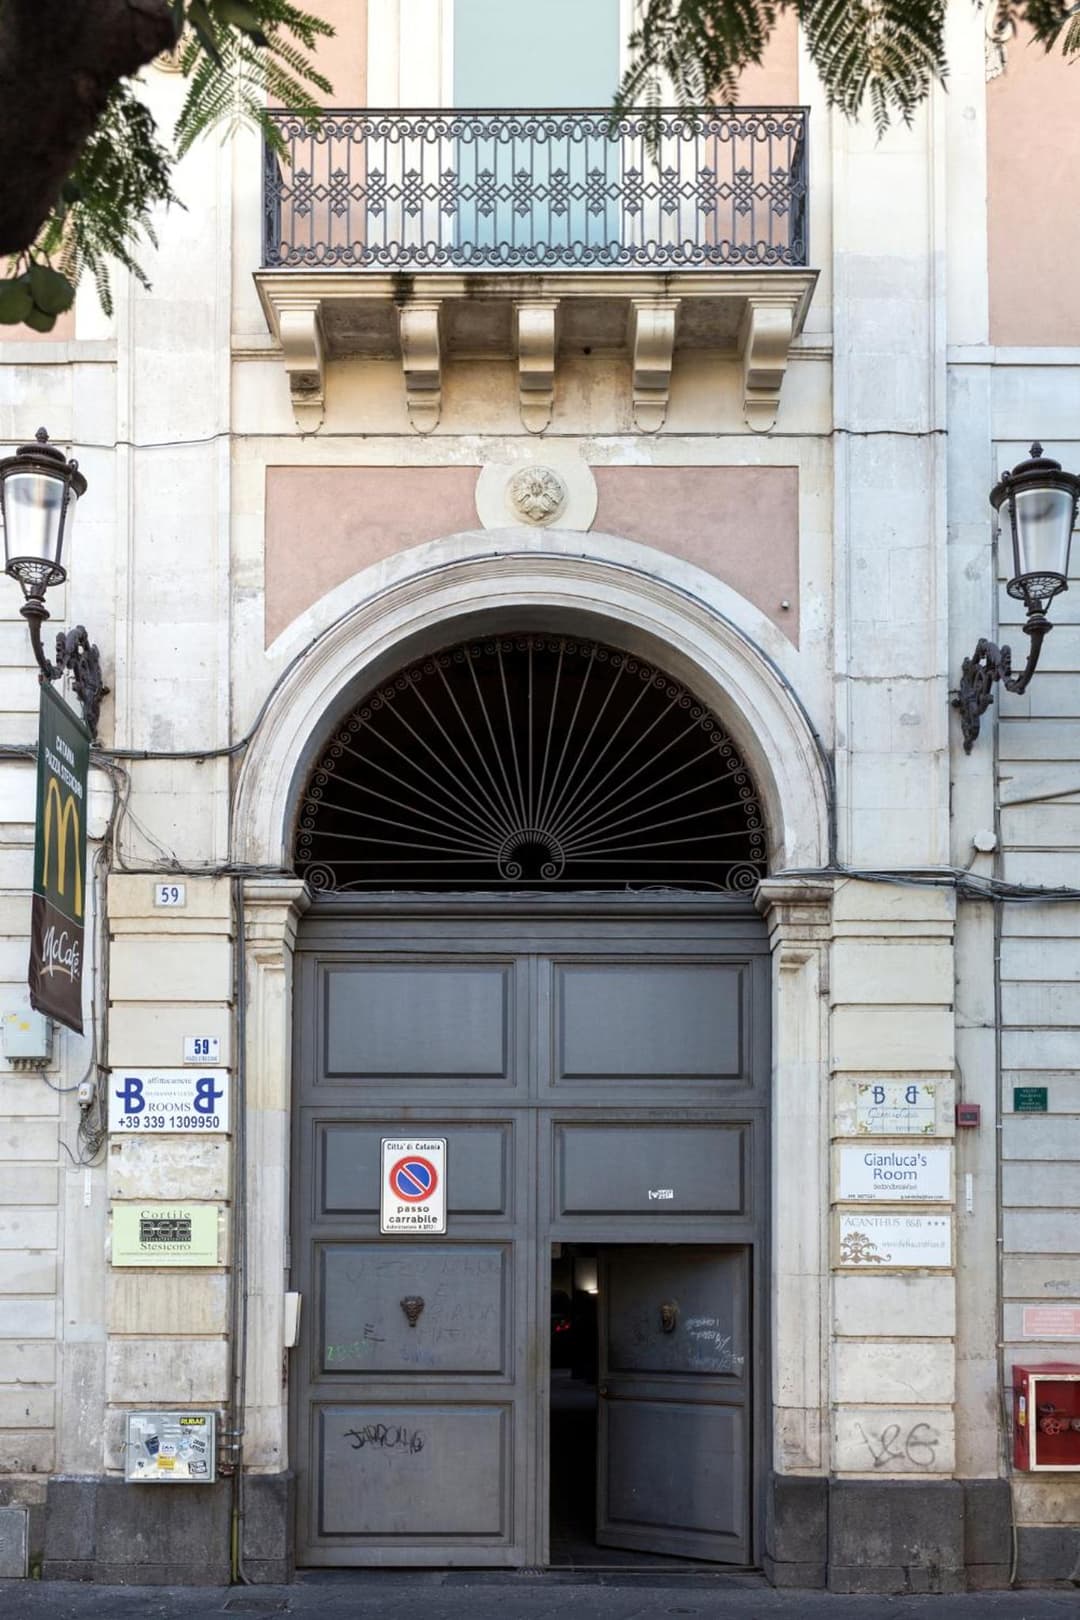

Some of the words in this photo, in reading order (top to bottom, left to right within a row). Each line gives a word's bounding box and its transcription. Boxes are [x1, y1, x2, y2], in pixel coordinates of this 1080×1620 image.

[161, 887, 179, 903] 59
[148, 1102, 191, 1112] ROOMS
[118, 1115, 140, 1129] +39
[143, 1115, 165, 1129] 339
[169, 1115, 220, 1129] 1309950
[864, 1152, 928, 1167] Gianluca's
[873, 1168, 918, 1181] Room
[140, 1210, 191, 1219] Cortile
[397, 1206, 430, 1214] passo
[389, 1214, 438, 1223] carrabile
[844, 1217, 901, 1227] ACANTHUS
[140, 1242, 191, 1251] Stesicoro
